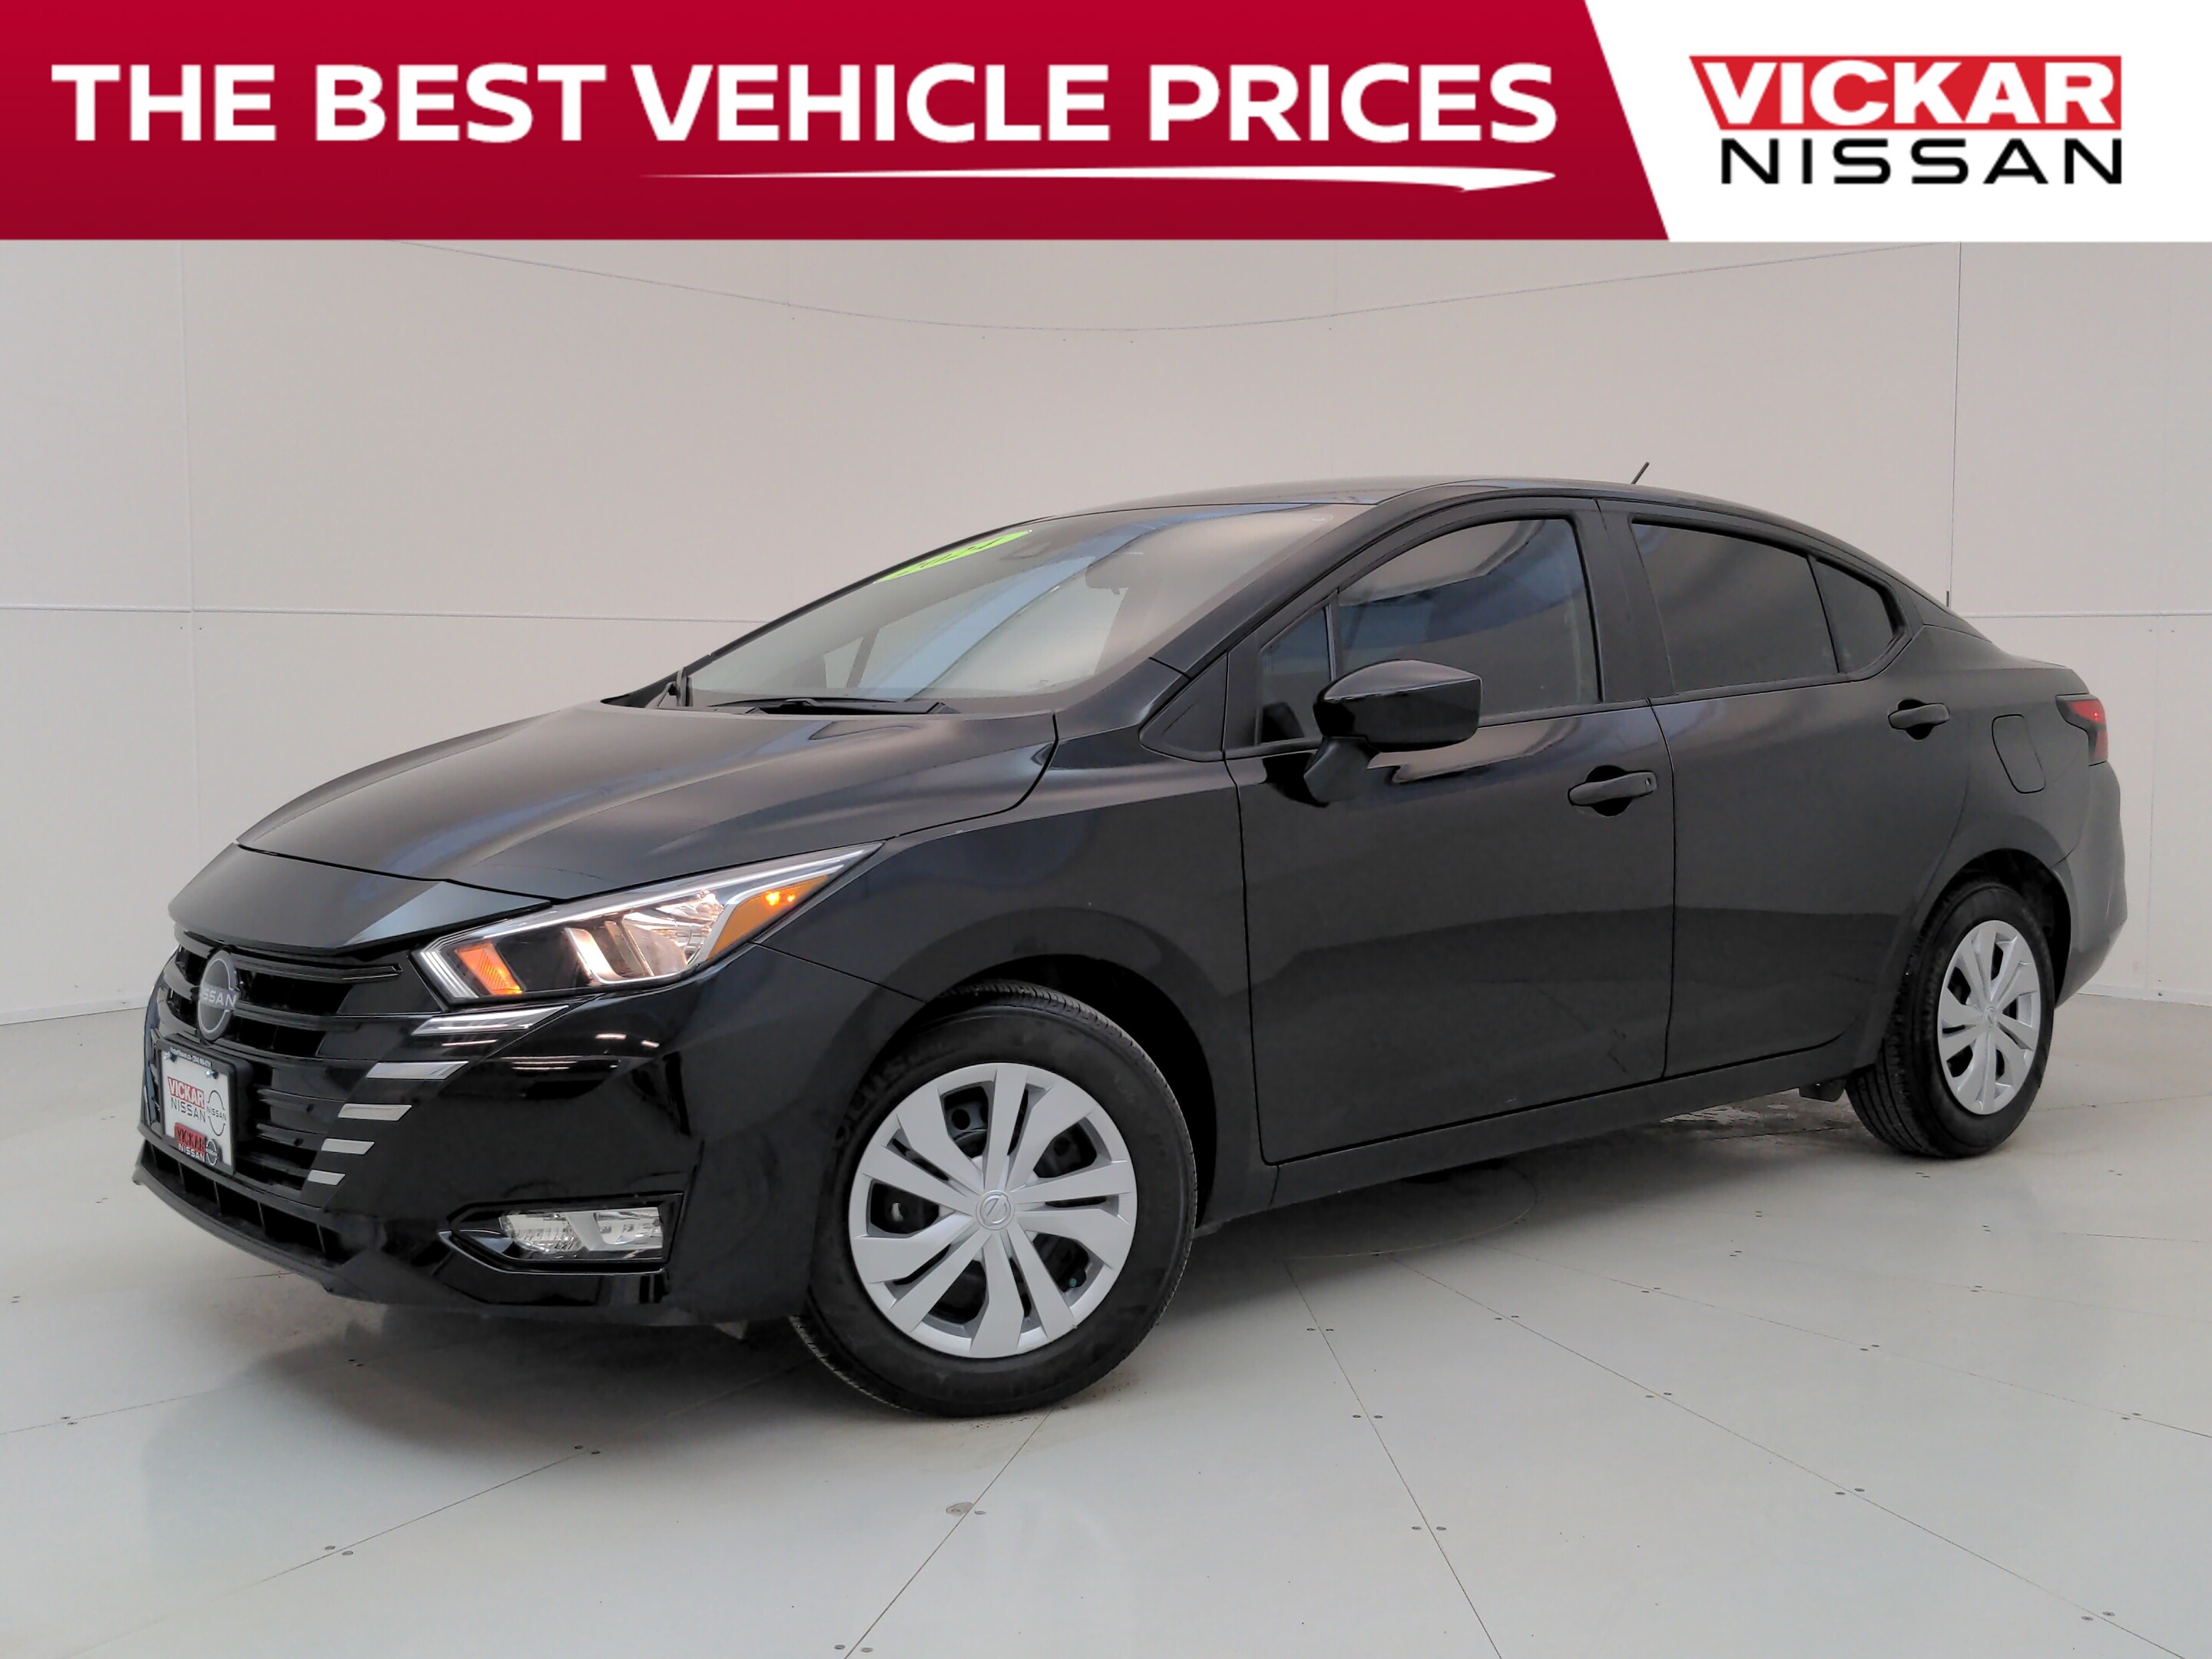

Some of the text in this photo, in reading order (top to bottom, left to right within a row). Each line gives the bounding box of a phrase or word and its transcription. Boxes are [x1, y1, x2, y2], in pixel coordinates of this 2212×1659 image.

[200, 988, 236, 1008] SSAN
[168, 1078, 204, 1109] VICKAR
[171, 1097, 206, 1122] NISSAN
[206, 1106, 227, 1121] NISSAN
[176, 1126, 205, 1154] VICKAR
[178, 1143, 205, 1162] NISSAN
